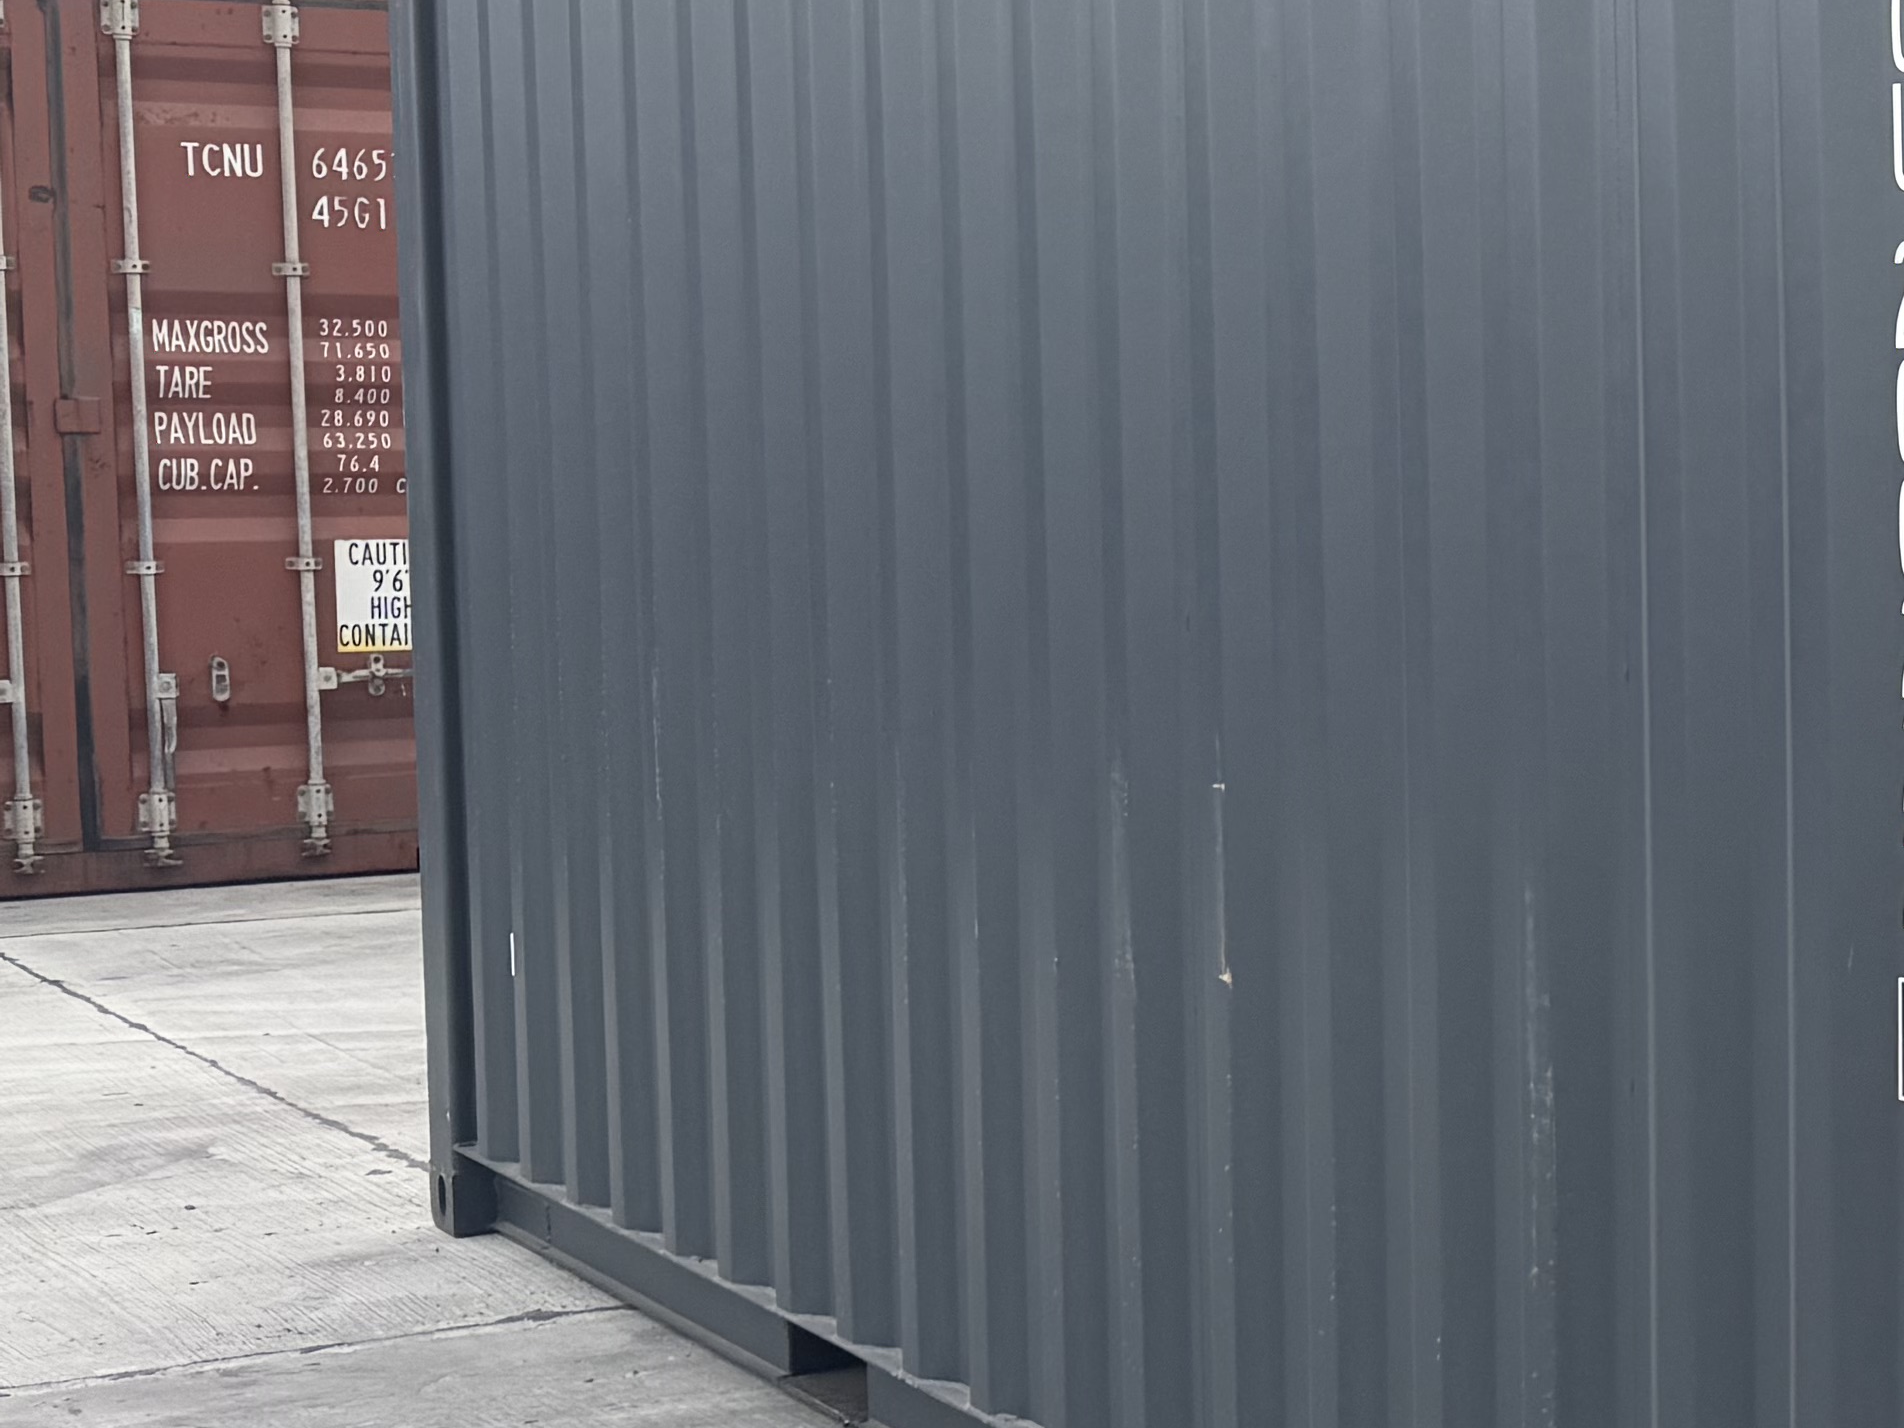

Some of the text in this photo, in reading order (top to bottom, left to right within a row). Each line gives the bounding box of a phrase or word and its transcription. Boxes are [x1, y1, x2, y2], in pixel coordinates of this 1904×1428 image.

[181, 141, 396, 182] TCNU 6465
[312, 195, 387, 230] 45G1
[152, 318, 269, 354] MAXGROSS
[156, 365, 213, 398] TARE
[154, 412, 257, 445] PAYLOAD
[158, 458, 259, 490] CUB.CAP.
[337, 454, 380, 472] 76.4
